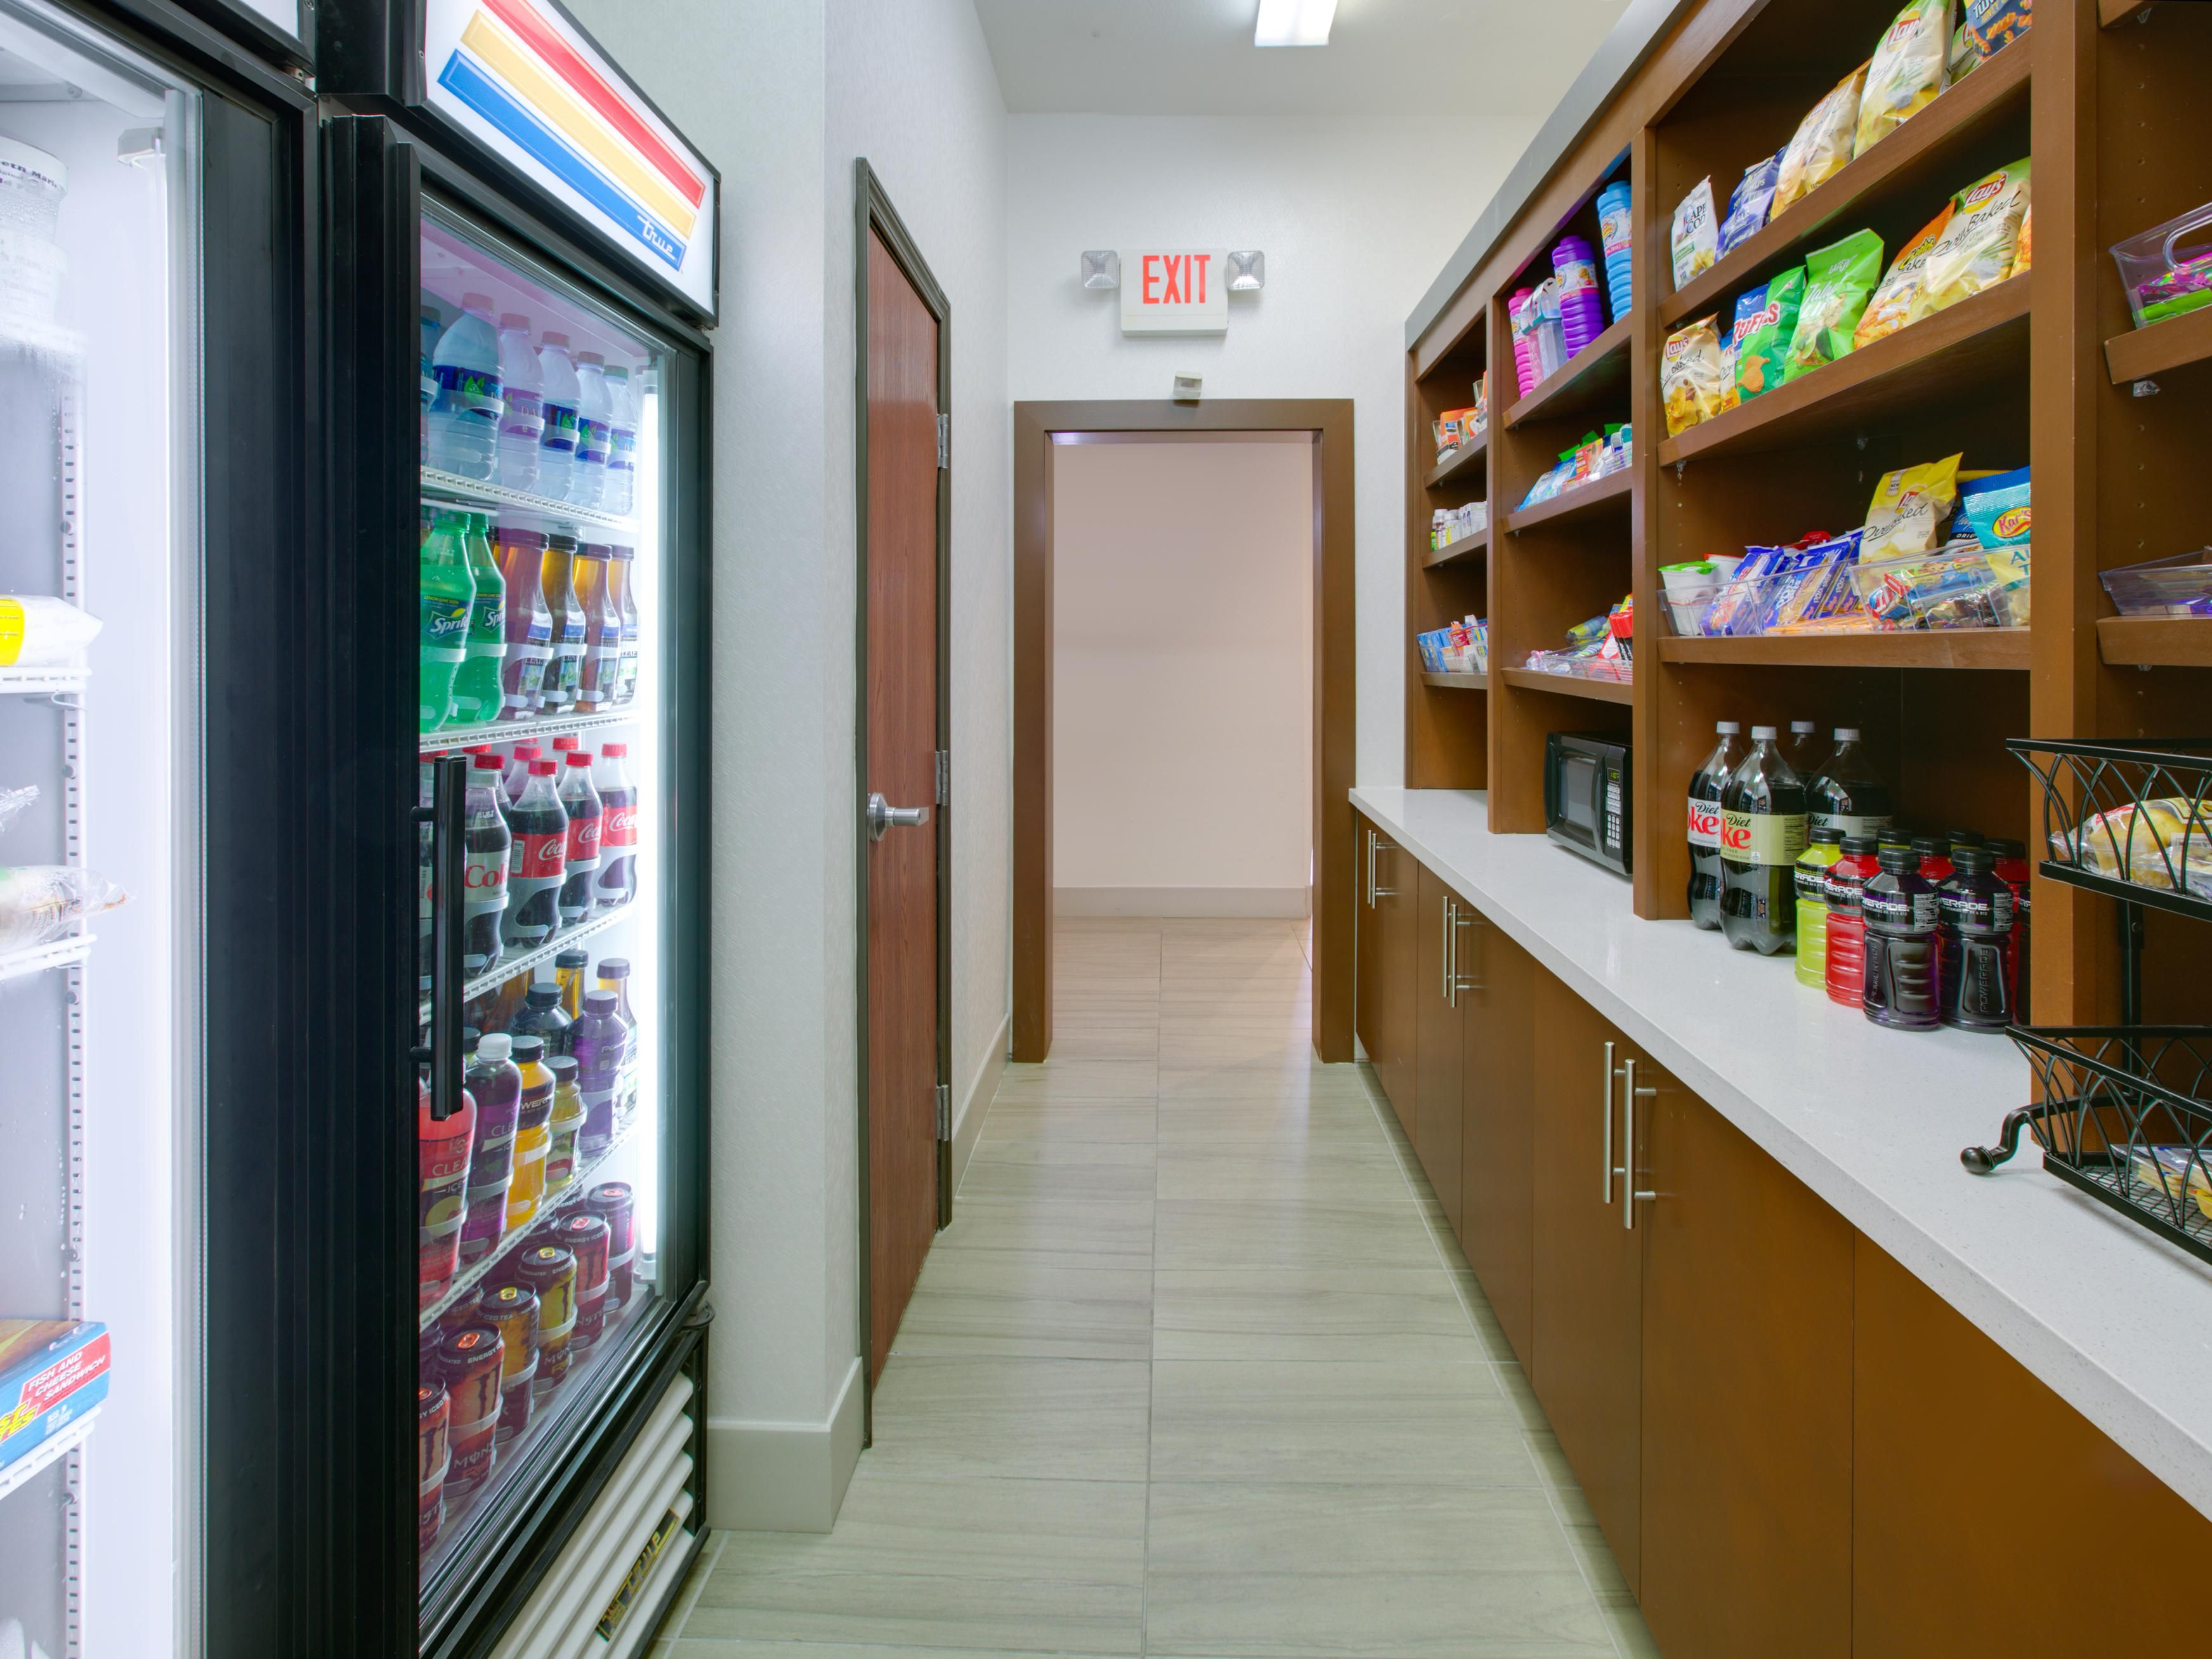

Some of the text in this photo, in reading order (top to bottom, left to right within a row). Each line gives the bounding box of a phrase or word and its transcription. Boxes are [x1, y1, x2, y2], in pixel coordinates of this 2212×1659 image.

[1965, 177, 2005, 206] Lay's
[1967, 190, 2022, 232] Baked
[1142, 254, 1211, 304] EXIT
[429, 613, 469, 634] Sprit
[1695, 801, 1720, 815] Diet
[1687, 806, 1720, 836] ke
[1726, 813, 1751, 827] Diet
[1808, 815, 1828, 827] Diet
[1721, 818, 1751, 850] ke
[1794, 871, 1825, 883] ERADE
[1826, 883, 1863, 895] ERADE
[1862, 896, 1908, 912] ERADE
[1939, 897, 1988, 911] ERADE
[1979, 947, 1989, 1013] POWERADE
[432, 1156, 468, 1176] CLEA
[468, 1349, 497, 1364] ENERGY
[28, 1368, 55, 1392] FISH
[58, 1351, 83, 1373] AND
[35, 1361, 83, 1397] CHEESE
[44, 1354, 106, 1401] SANDWICH
